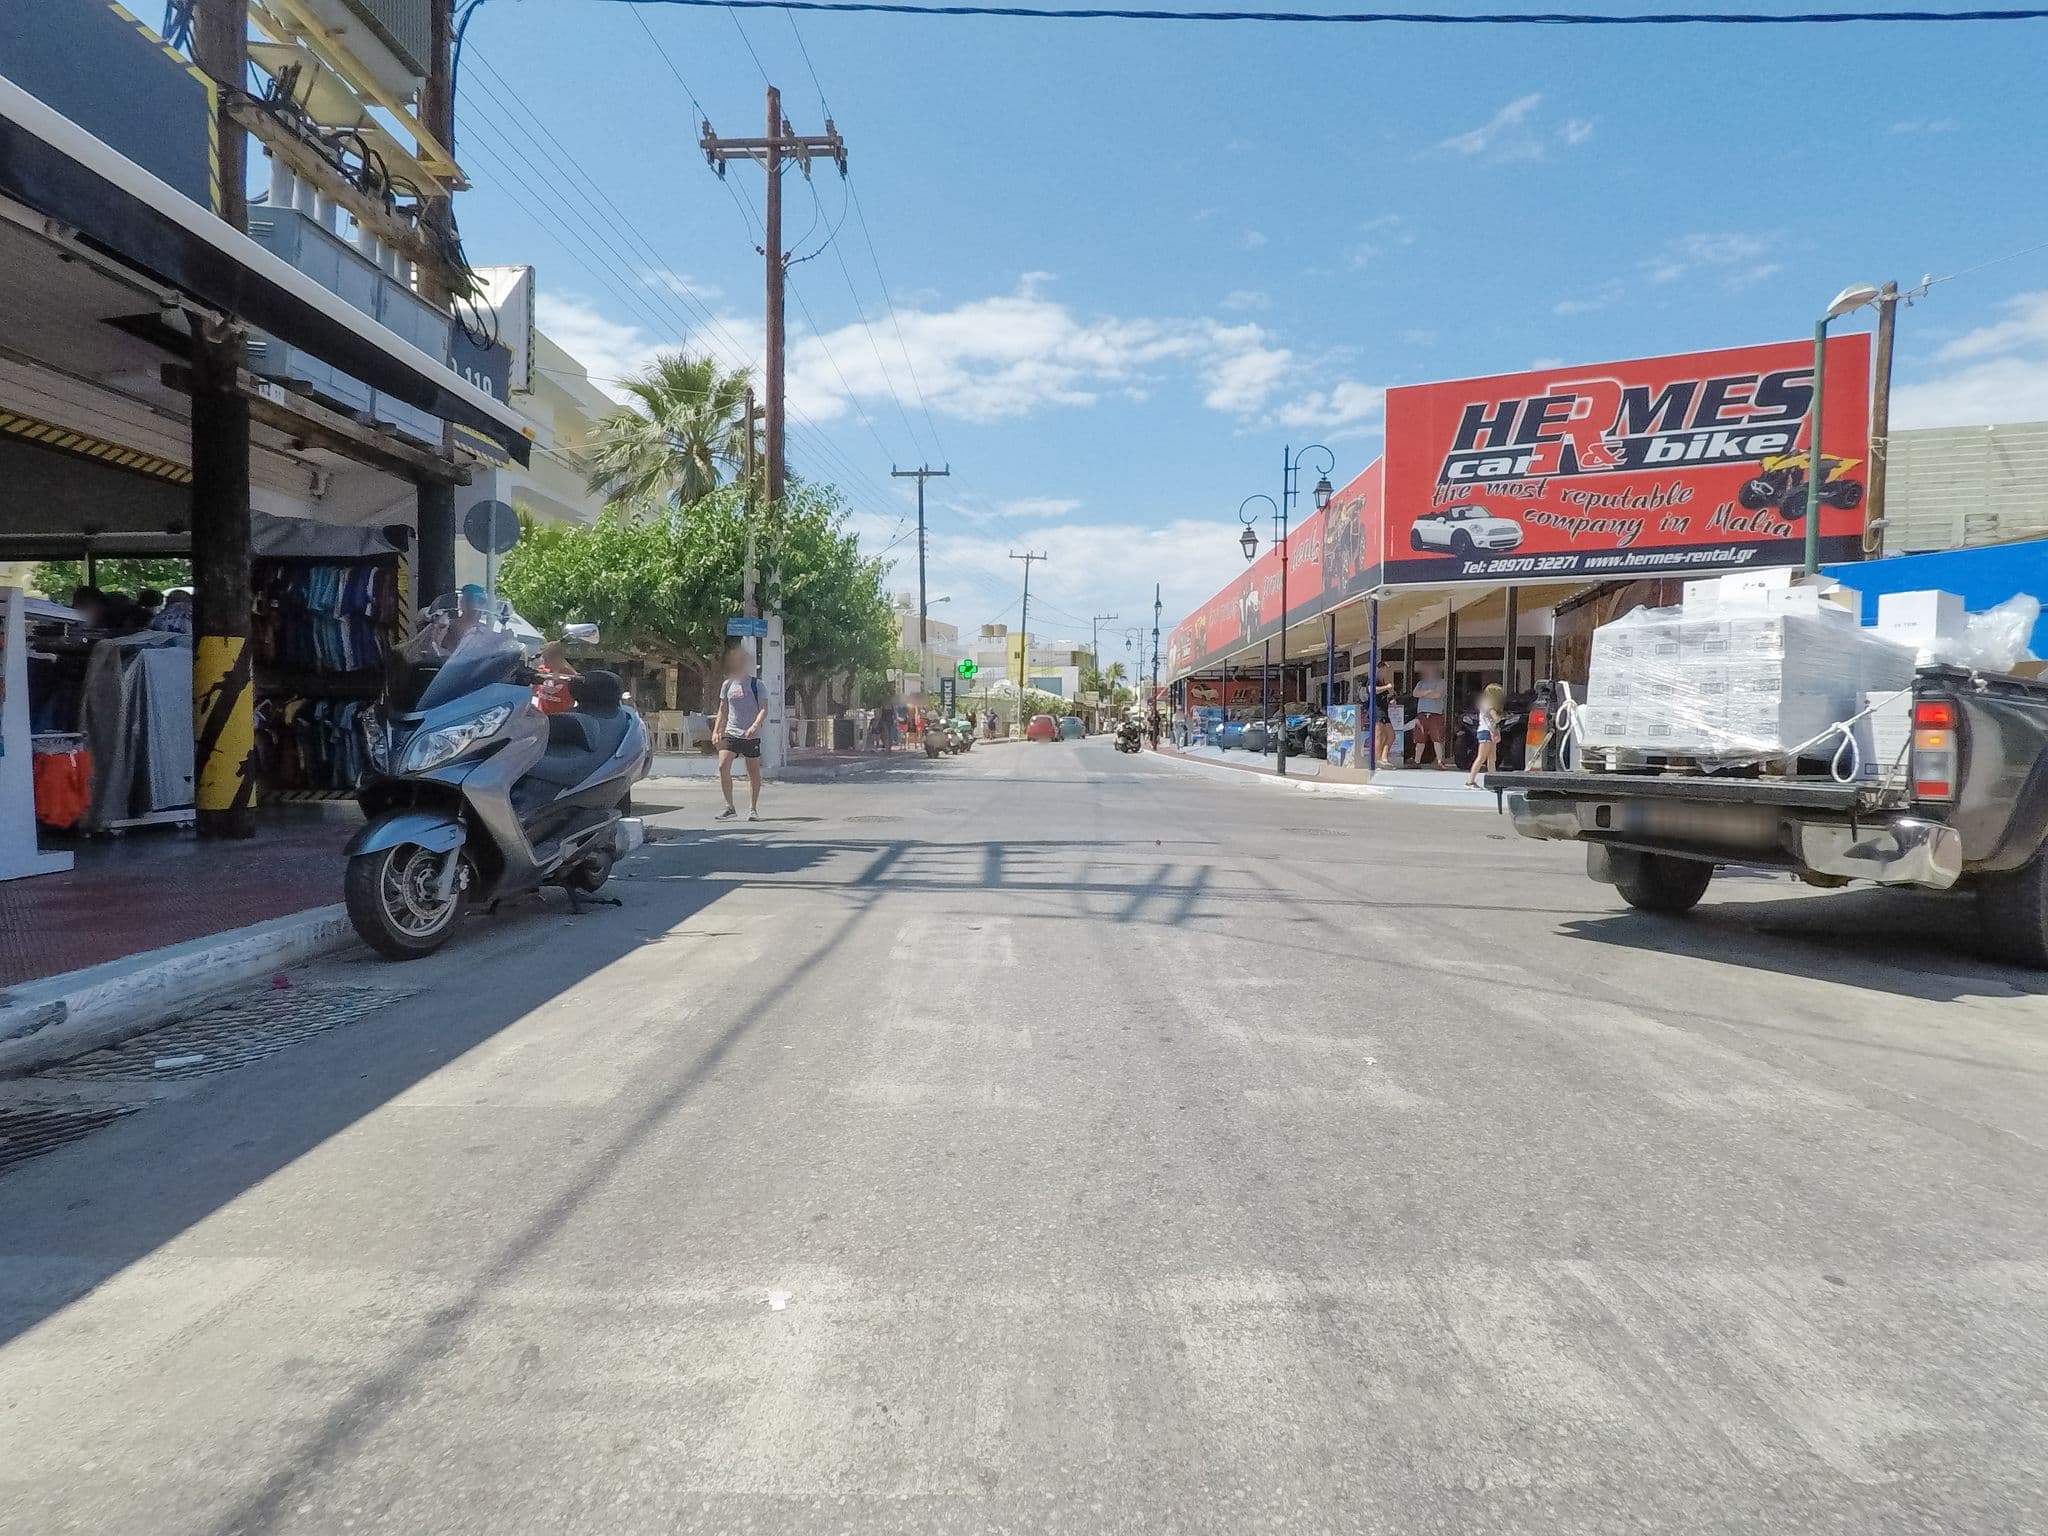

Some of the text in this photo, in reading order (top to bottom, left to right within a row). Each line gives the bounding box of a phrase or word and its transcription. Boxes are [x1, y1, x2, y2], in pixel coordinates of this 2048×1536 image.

[1452, 368, 1815, 476] HERMES
[1447, 431, 1789, 480] car & bike
[1432, 476, 1695, 515] the most reputable
[1523, 502, 1794, 548] company in Malia
[1462, 546, 1758, 574] Tel: 28970 32271 www.hermes-rental.gr
